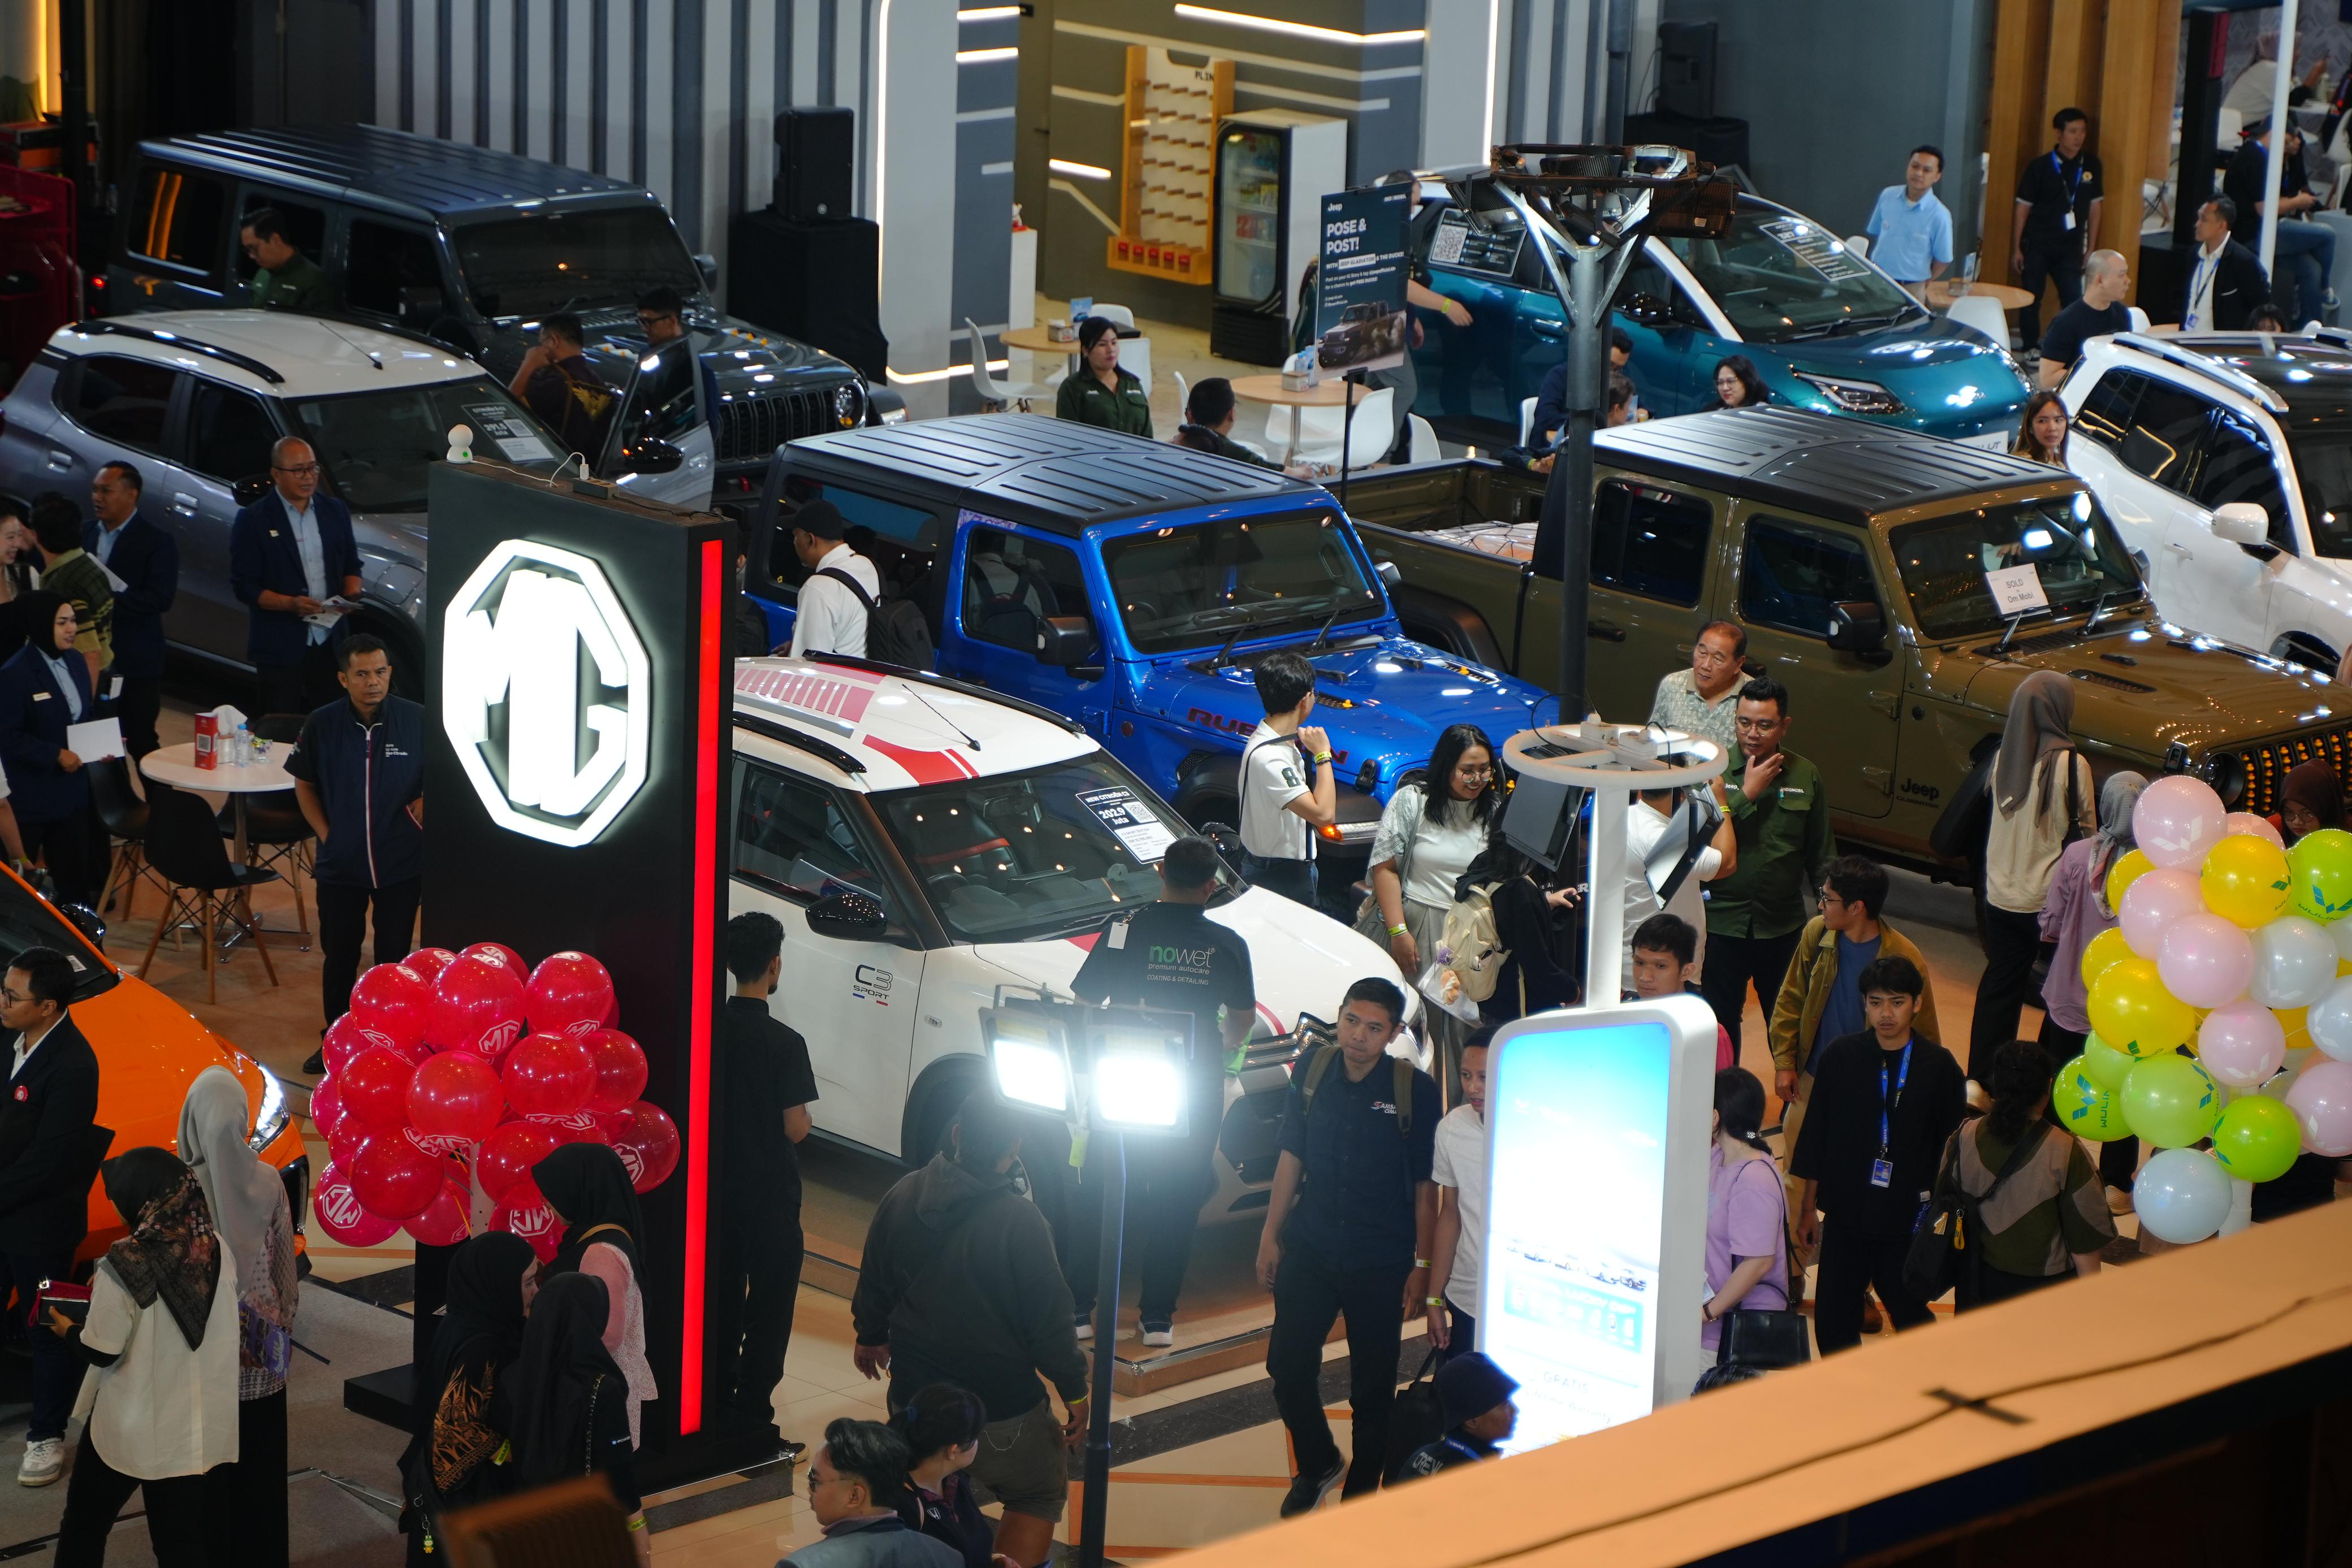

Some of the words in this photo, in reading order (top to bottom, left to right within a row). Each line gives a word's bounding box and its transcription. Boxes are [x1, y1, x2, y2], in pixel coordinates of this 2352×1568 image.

[1328, 203, 1342, 211] Jeep
[1327, 219, 1357, 237] POSE
[1359, 218, 1367, 232] &
[1326, 236, 1360, 254] POST!
[2006, 579, 2024, 588] SOLD
[2019, 592, 2034, 601] Mobi
[467, 569, 628, 816] MG
[1282, 767, 1301, 787] 8
[1901, 778, 1939, 800] Jeep
[1099, 807, 1126, 819] 202.9
[855, 964, 893, 991] C3
[1179, 965, 1210, 974] autocare
[1178, 976, 1209, 985] DETAILING
[854, 985, 889, 999] SPORT
[2101, 1091, 2109, 1128] WULIN
[325, 1189, 358, 1224] MG
[1544, 1371, 1588, 1393] GRATIS
